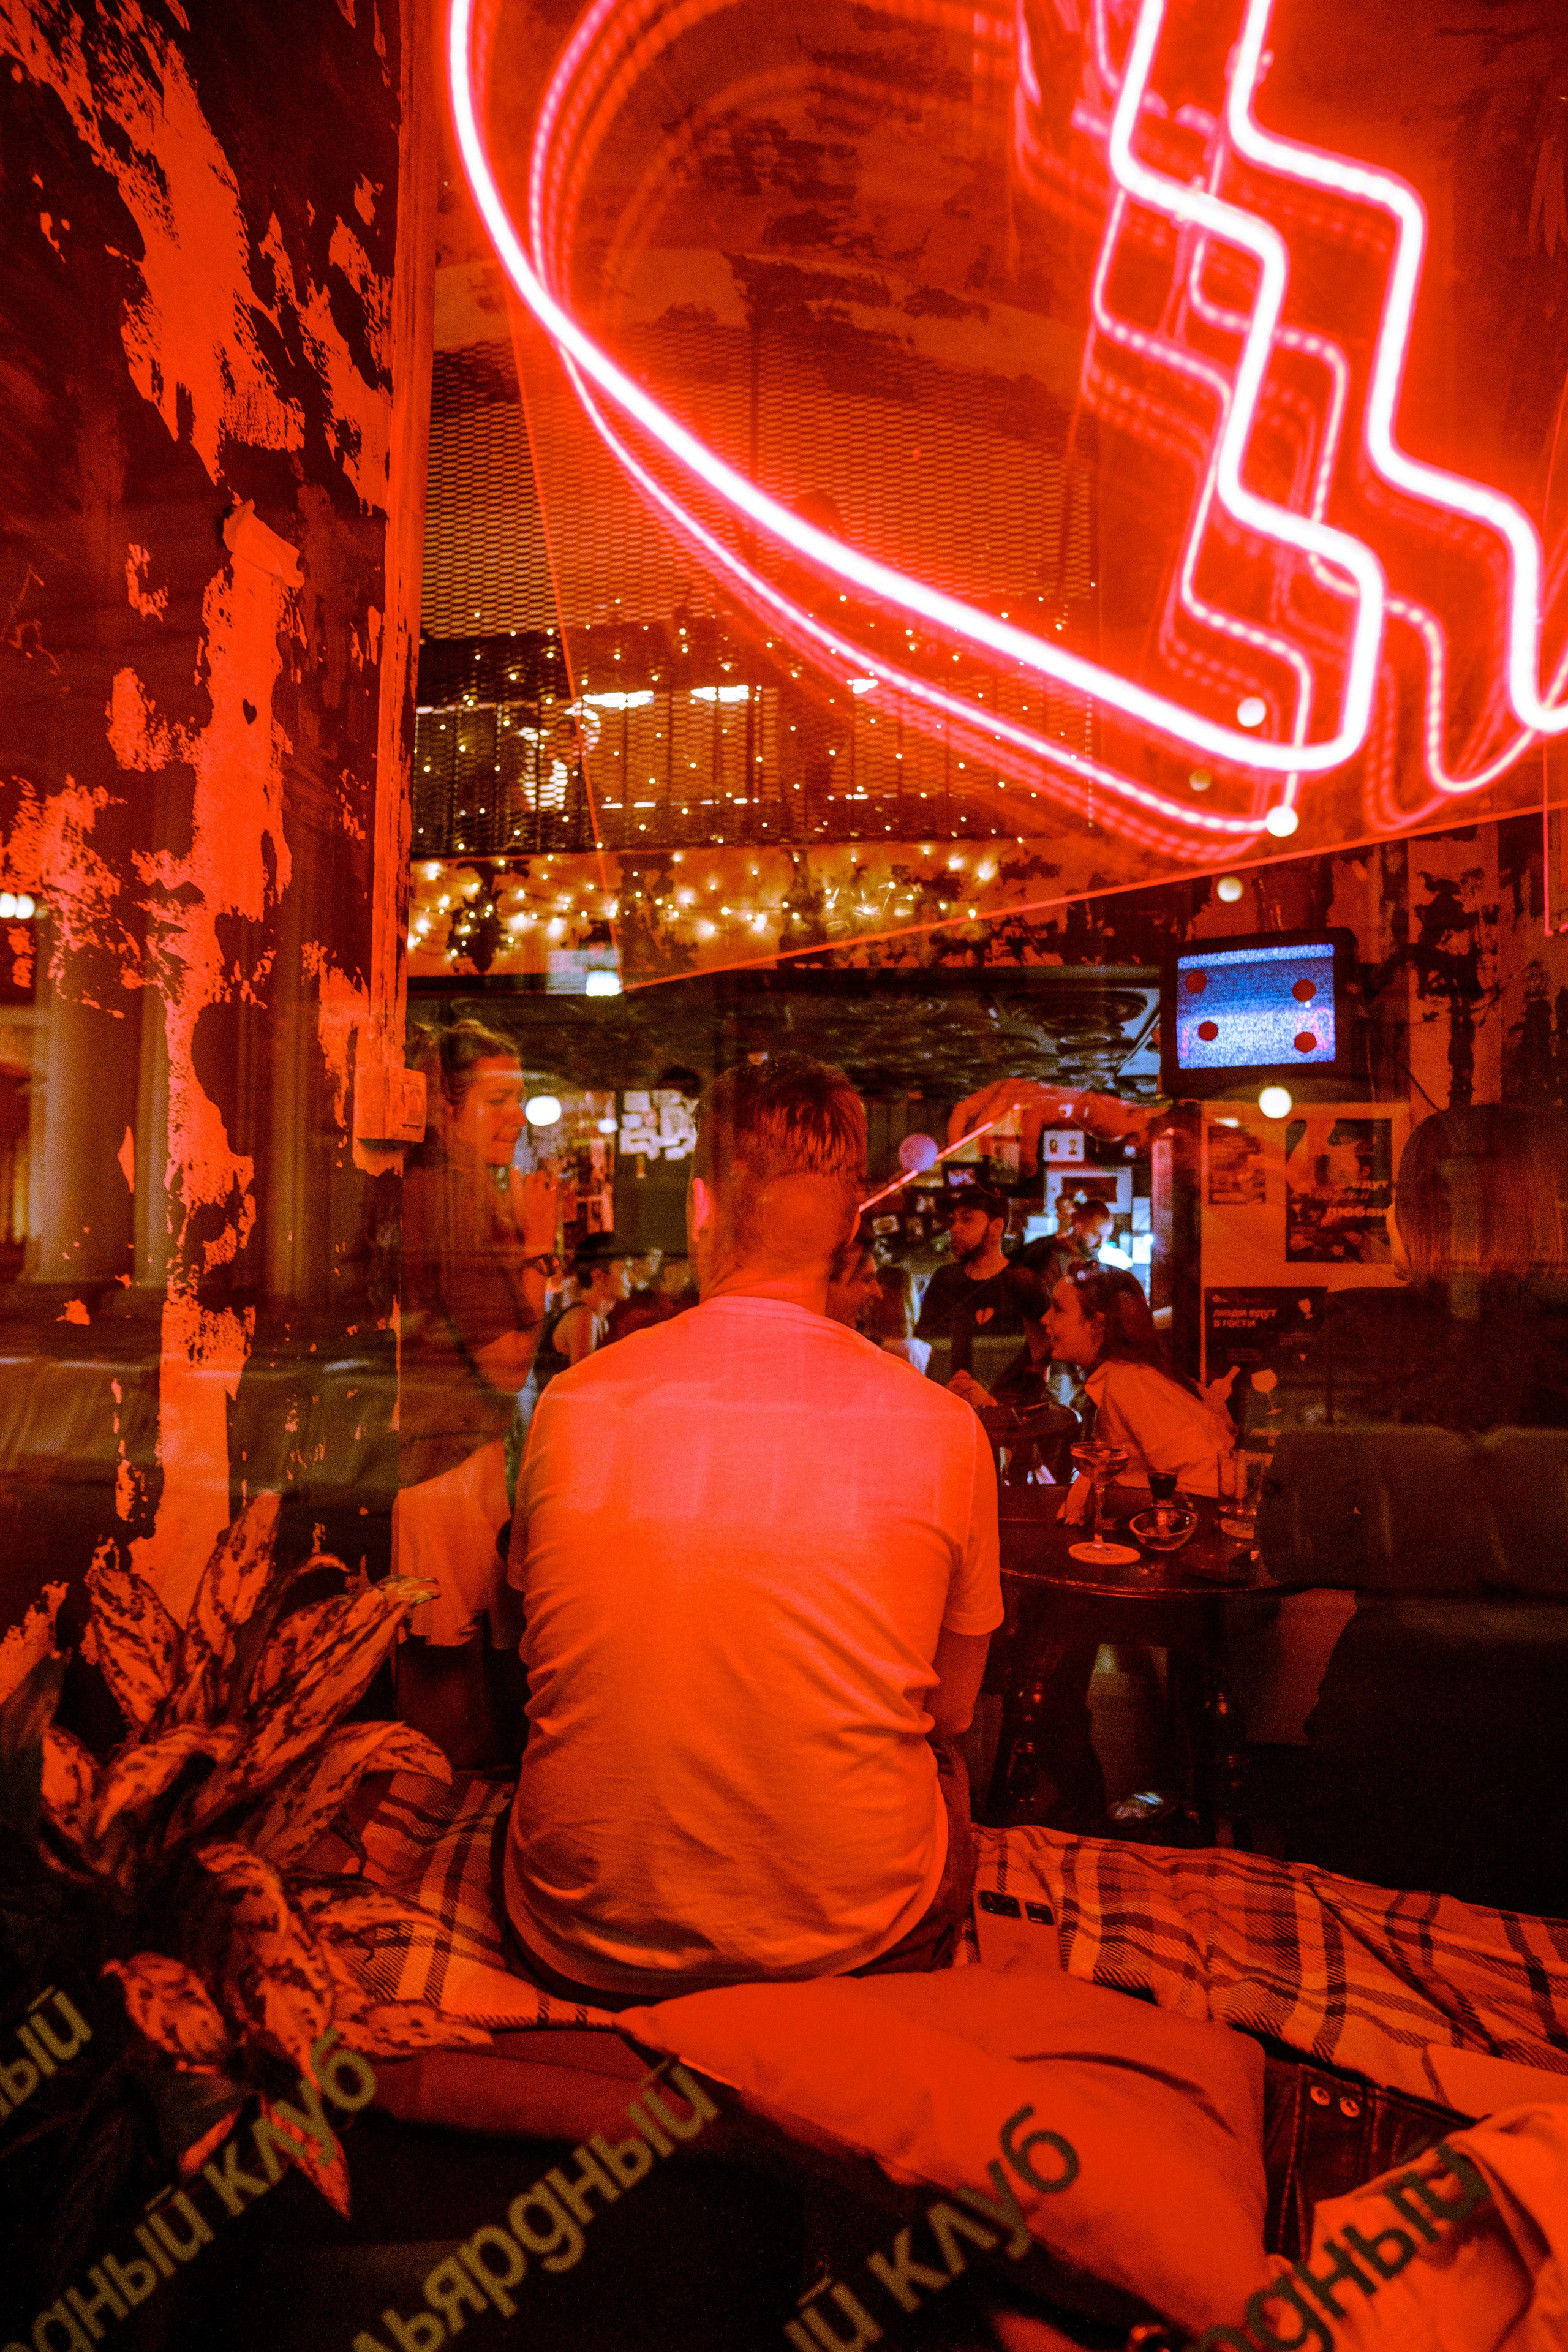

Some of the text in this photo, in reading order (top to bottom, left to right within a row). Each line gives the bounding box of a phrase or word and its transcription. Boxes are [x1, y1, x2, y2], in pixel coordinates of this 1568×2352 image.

[0, 1986, 92, 2117] ый
[203, 2027, 377, 2216] клуб
[867, 2103, 1080, 2313] клуб
